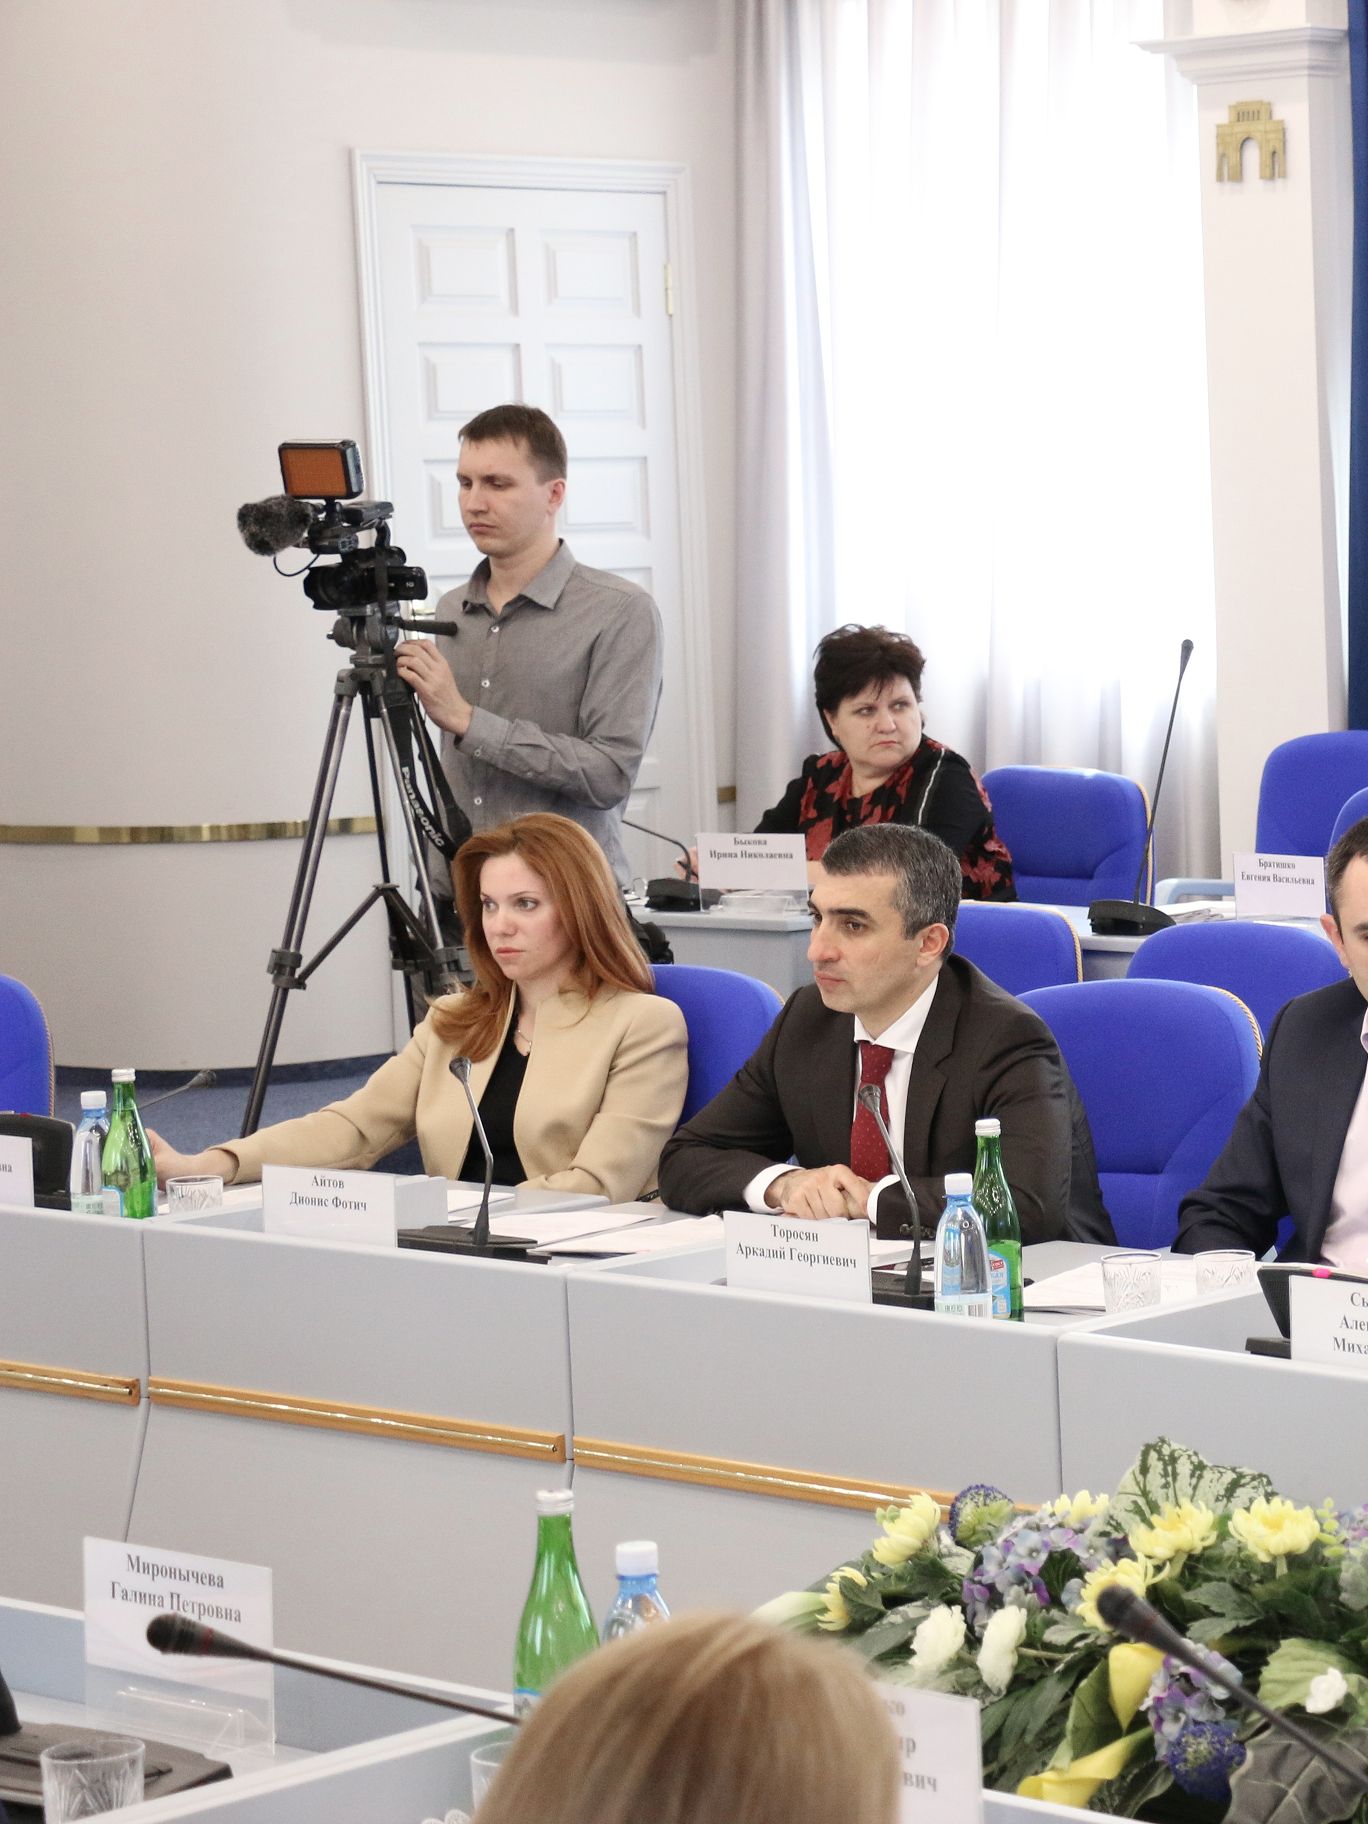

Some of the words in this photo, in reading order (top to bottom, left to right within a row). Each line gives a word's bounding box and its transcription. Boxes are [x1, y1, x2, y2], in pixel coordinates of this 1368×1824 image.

[402, 766, 445, 847] Panasonic
[709, 849, 738, 860] Ирина
[740, 849, 794, 860] Николаевна
[1258, 858, 1296, 871] Братишко
[1241, 871, 1271, 882] Евгения
[1272, 873, 1315, 885] Васильевна
[311, 1175, 345, 1189] Айтов
[289, 1191, 329, 1208] Дионис
[332, 1196, 367, 1211] Фотич
[770, 1224, 819, 1243] Торосян
[736, 1242, 786, 1260] Аркадий
[789, 1247, 857, 1268] Георгиевич
[126, 1553, 225, 1589] Миронычева
[110, 1581, 165, 1609] Галина
[169, 1591, 242, 1623] Петровна
